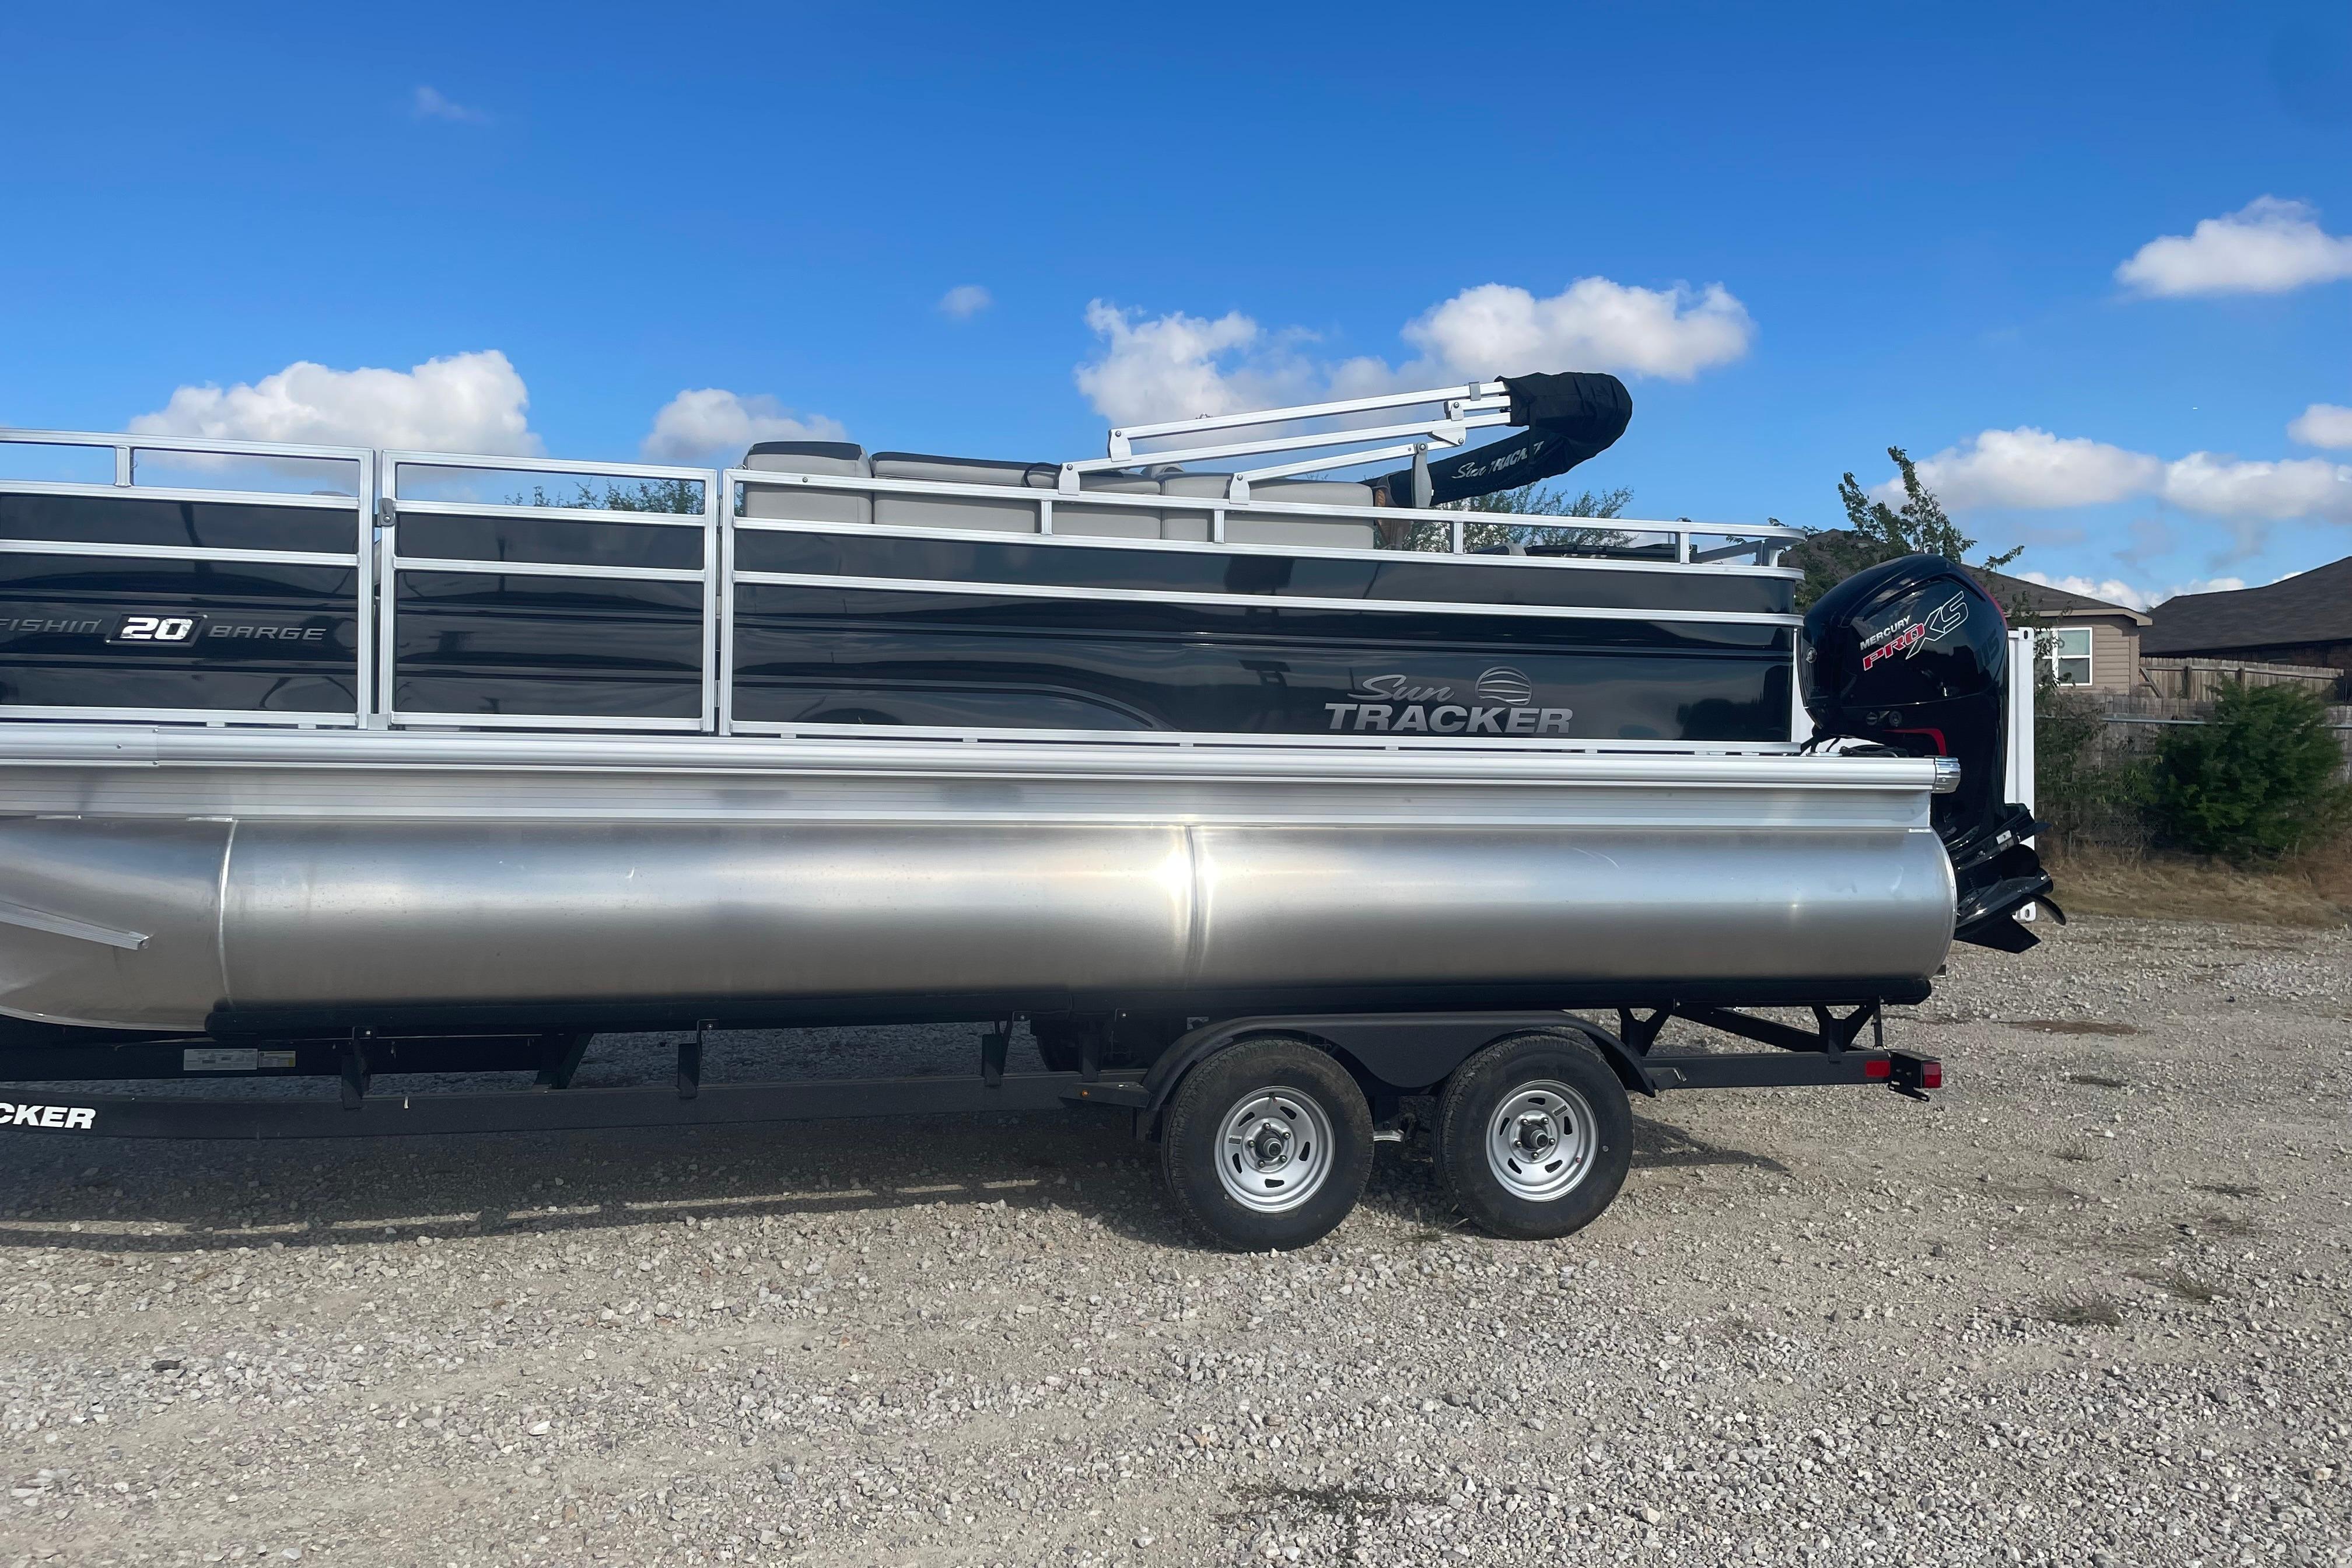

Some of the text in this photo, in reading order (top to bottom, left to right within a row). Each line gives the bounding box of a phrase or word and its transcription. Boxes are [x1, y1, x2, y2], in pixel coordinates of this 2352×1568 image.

[120, 617, 194, 640] 20
[208, 625, 327, 641] BARGE
[1860, 615, 1911, 651] MERCURY
[1863, 622, 1925, 671] PRO
[1346, 674, 1455, 702] Sun
[1324, 702, 1574, 733] TRACKER
